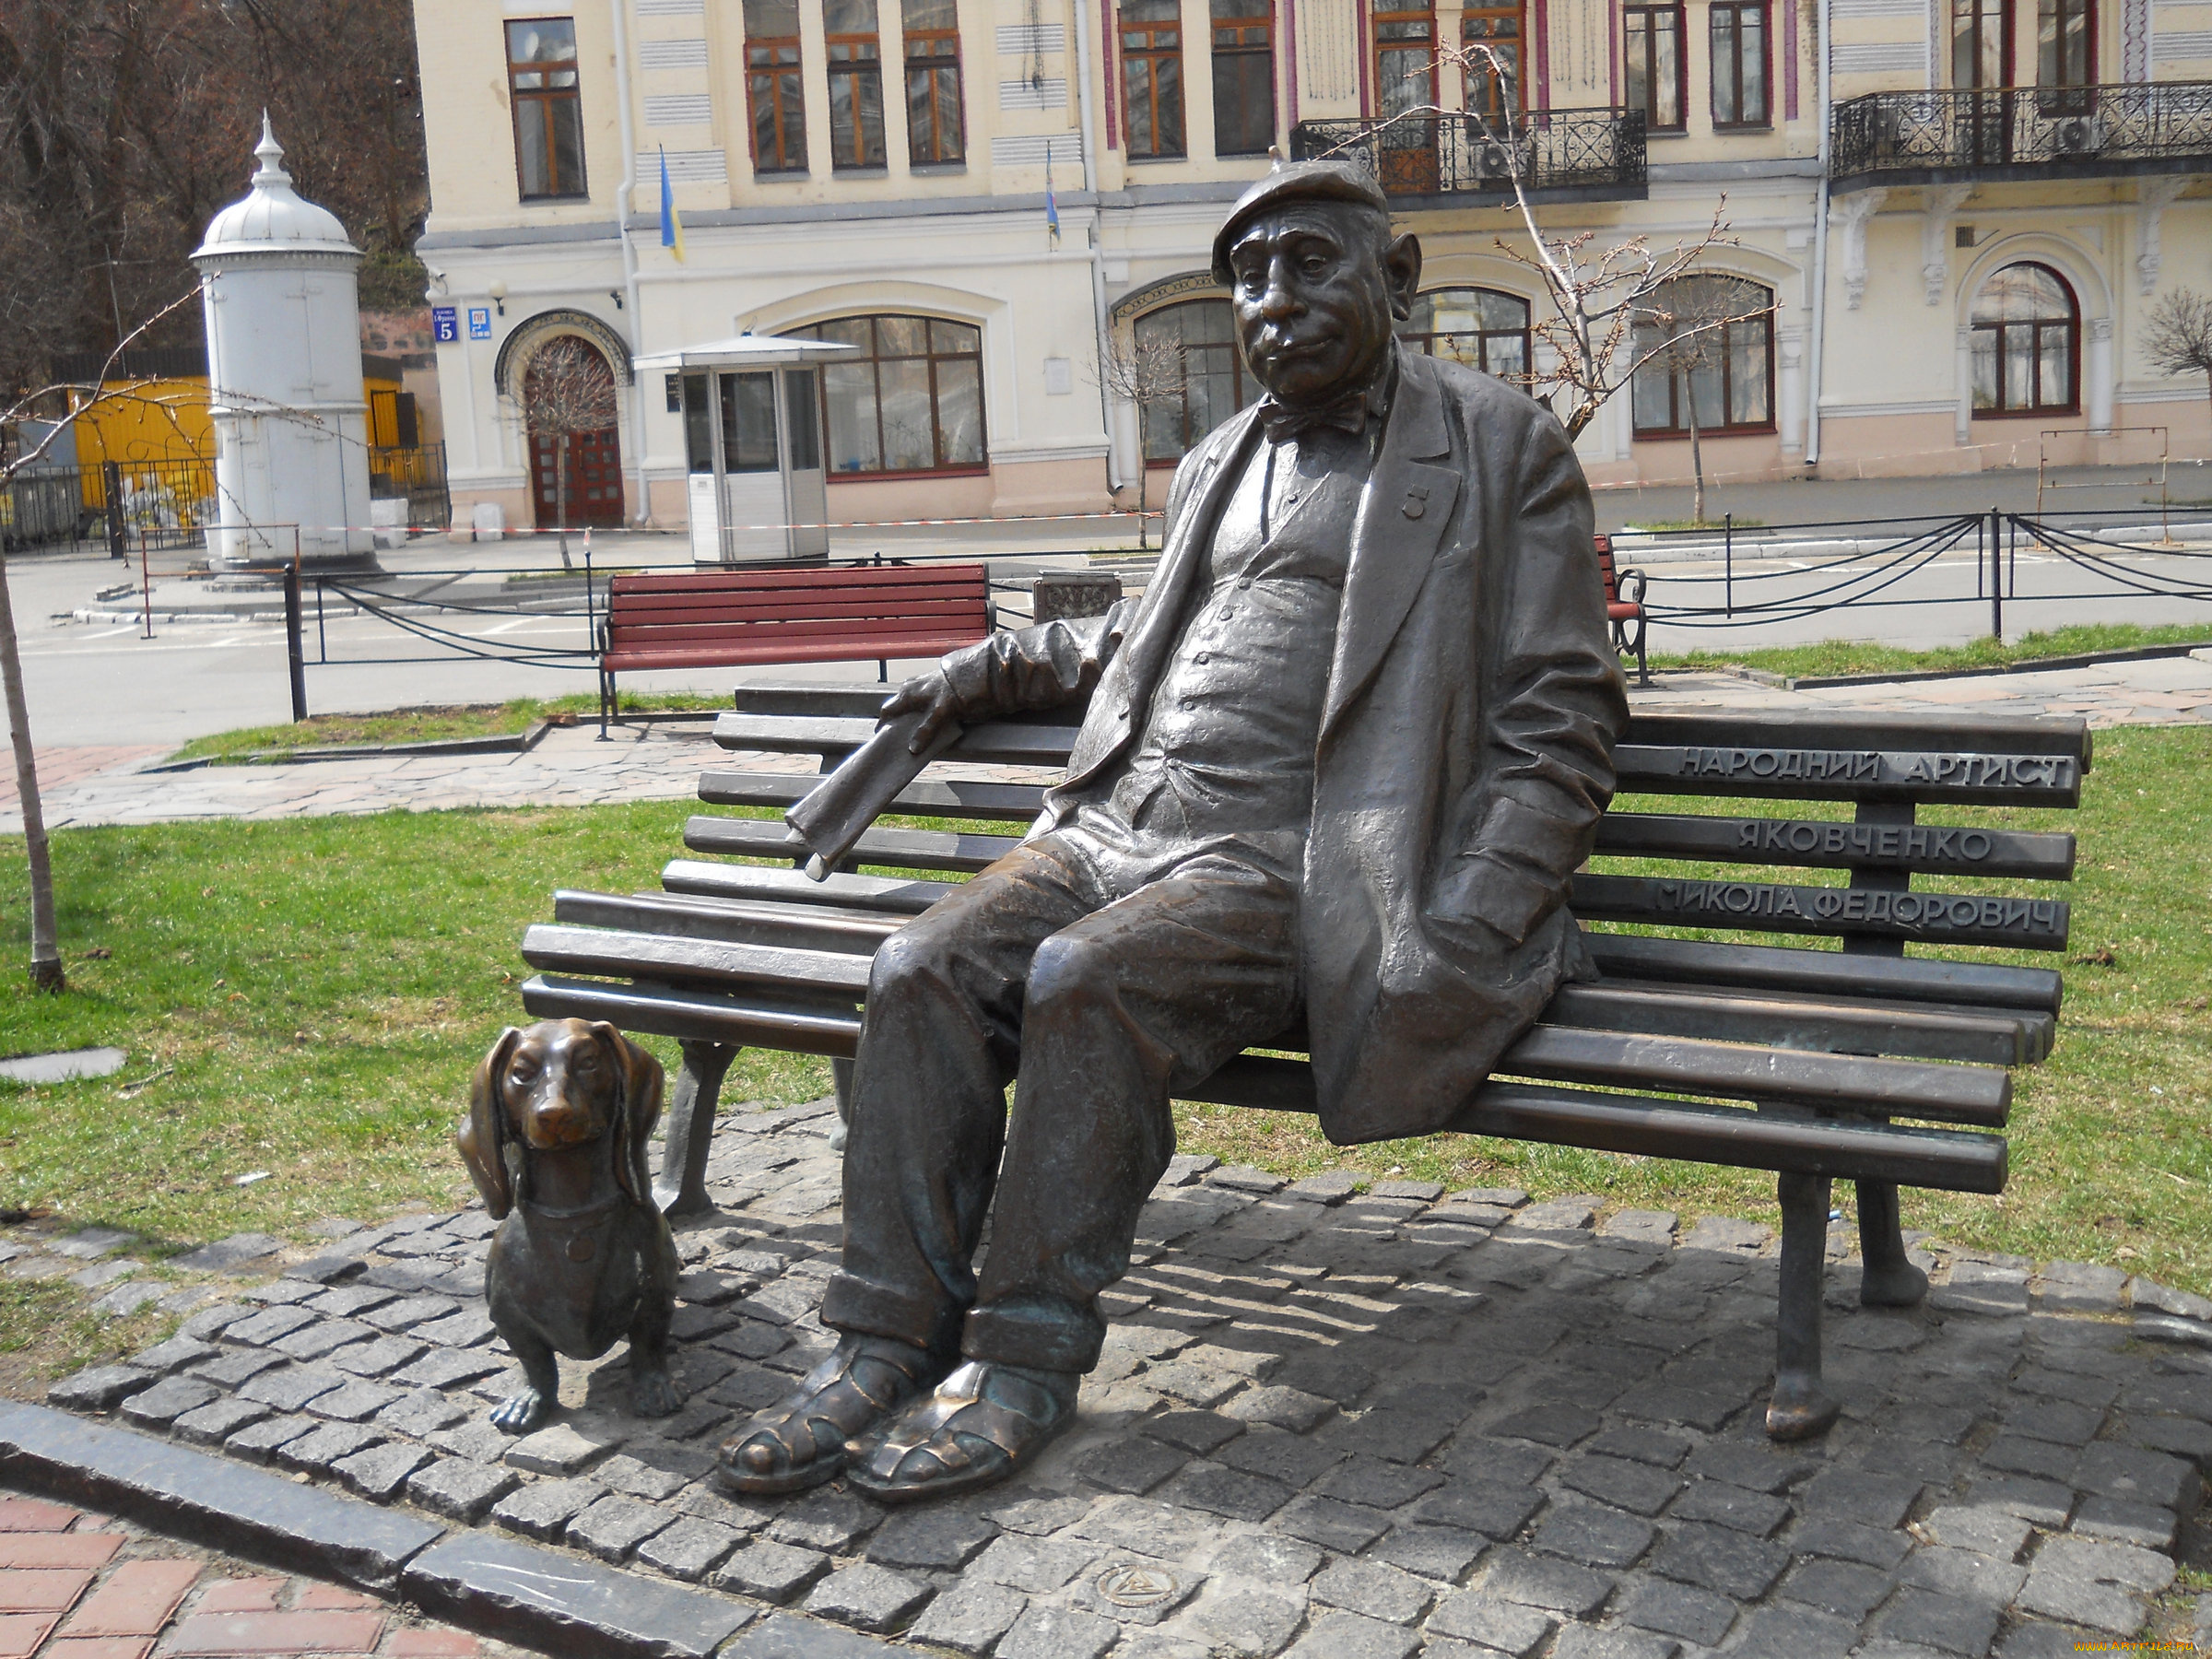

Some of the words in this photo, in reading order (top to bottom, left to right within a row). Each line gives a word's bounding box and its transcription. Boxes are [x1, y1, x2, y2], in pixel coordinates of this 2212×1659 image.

[441, 323, 453, 340] 5
[1679, 747, 1879, 781] НАРОДНИЙ
[1904, 754, 2067, 786] АРТИСТ
[1738, 821, 1992, 860] ЯКОВЧЕНКО
[1657, 881, 1802, 915] МИКОЛА
[1813, 890, 2056, 932] ФЕДОРОВИЧ
